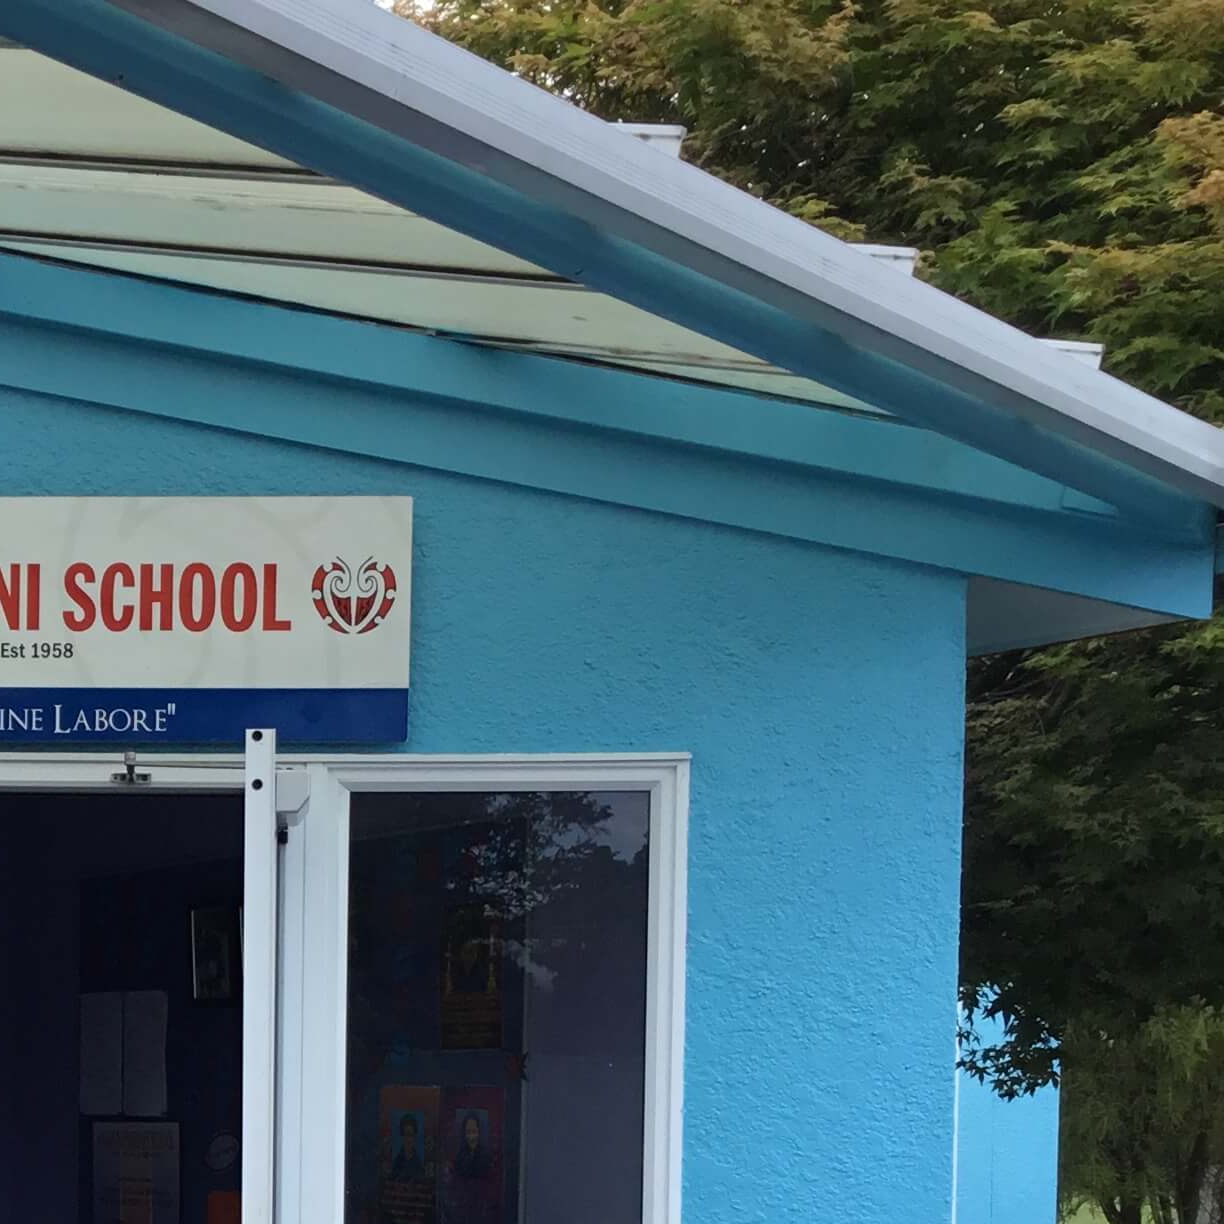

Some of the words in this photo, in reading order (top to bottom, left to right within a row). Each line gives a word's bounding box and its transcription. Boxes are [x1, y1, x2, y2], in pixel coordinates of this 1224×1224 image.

[62, 561, 291, 633] SCHOOL
[0, 642, 26, 659] Est
[31, 642, 74, 659] 1958
